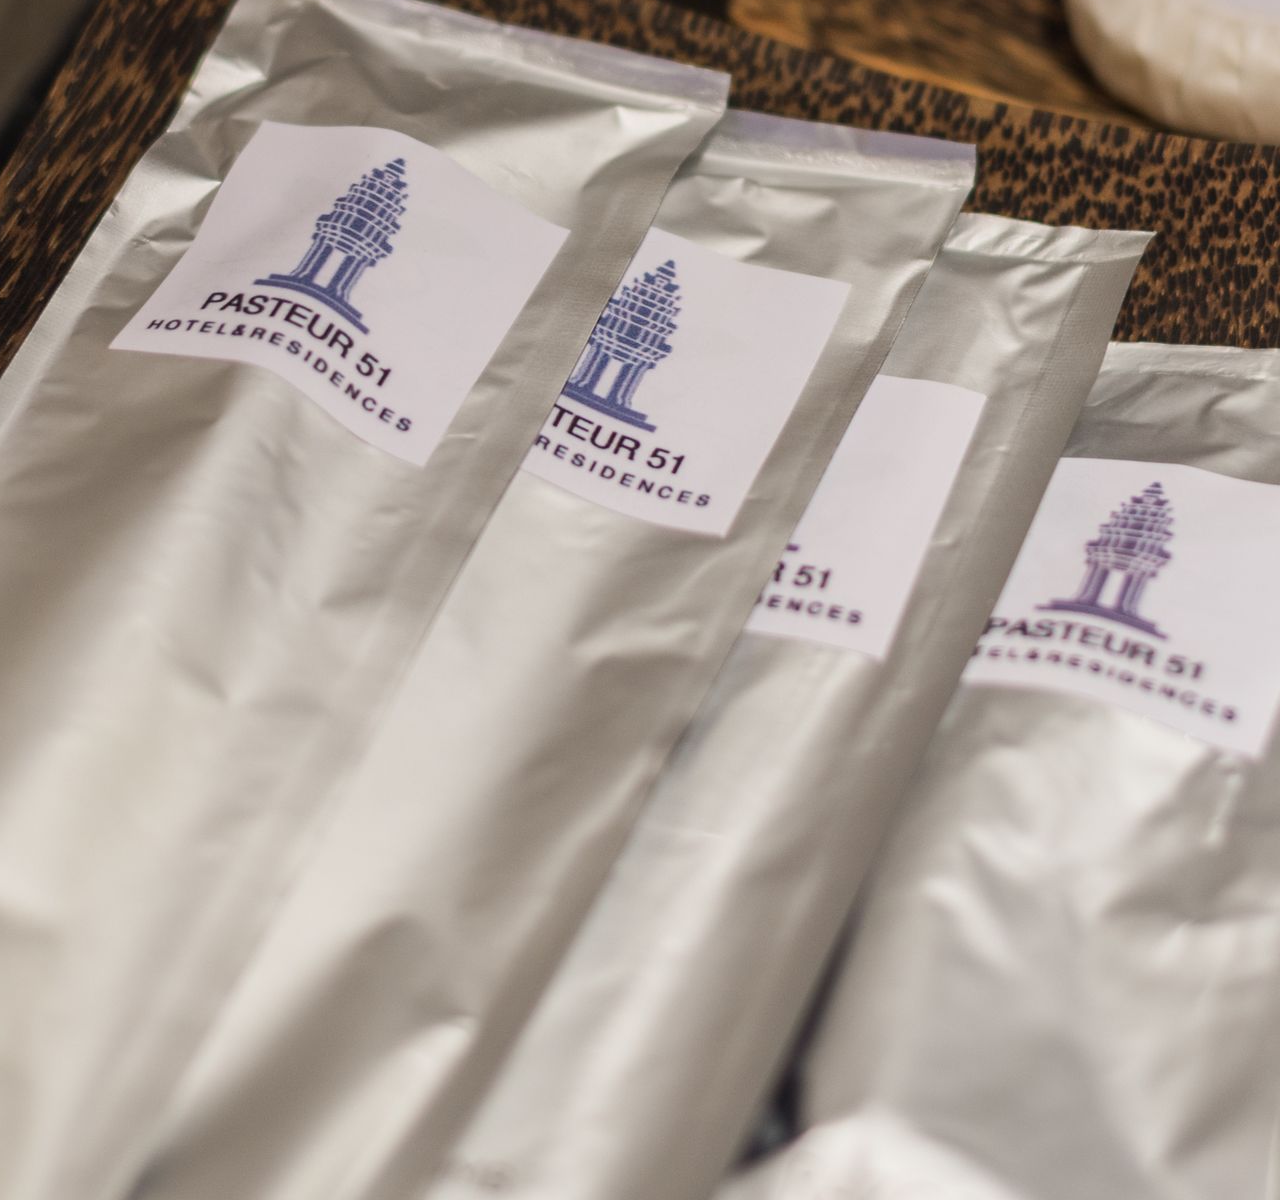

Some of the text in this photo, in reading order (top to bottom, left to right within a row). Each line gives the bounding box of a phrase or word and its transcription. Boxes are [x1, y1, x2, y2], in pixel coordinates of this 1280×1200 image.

[200, 291, 392, 388] PASTEUR 51
[146, 317, 412, 433] HOTEL&RESIDENCES
[534, 434, 712, 508] RESIDENCES
[646, 447, 686, 476] 51
[792, 564, 833, 591] 51
[982, 616, 1205, 681] PASTEUR 51
